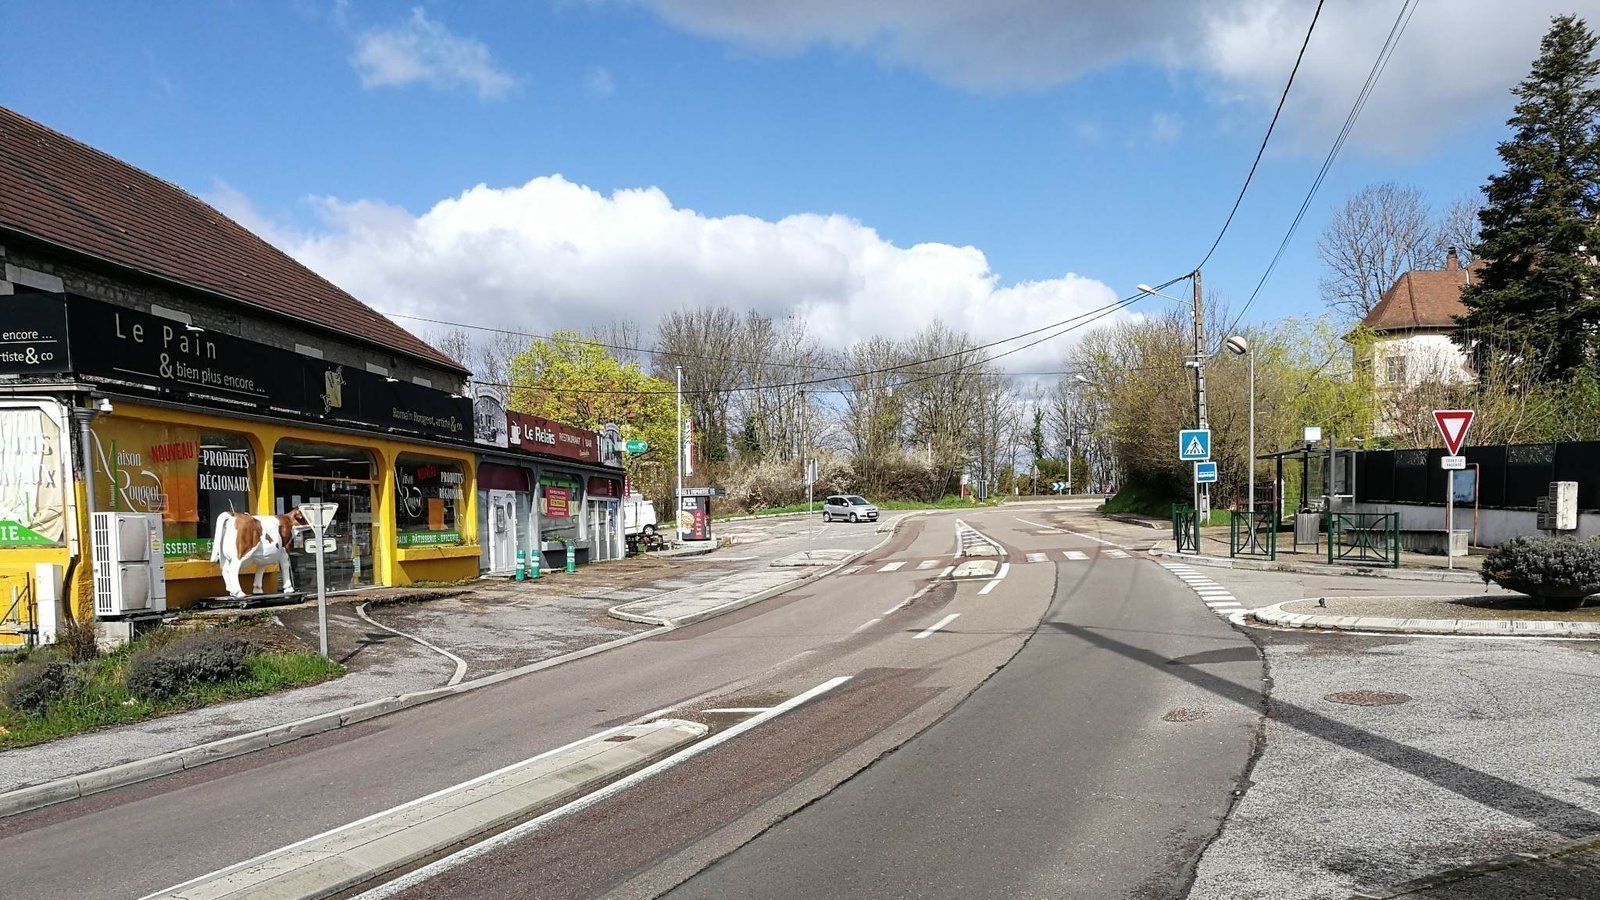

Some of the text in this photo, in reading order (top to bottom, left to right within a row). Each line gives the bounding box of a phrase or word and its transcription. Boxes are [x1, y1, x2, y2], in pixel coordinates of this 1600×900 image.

[2, 331, 39, 341] encore
[115, 313, 216, 359] Le Pain
[41, 352, 54, 361] co
[159, 352, 174, 379] &
[177, 361, 199, 380] bien
[202, 368, 222, 384] plus
[223, 374, 254, 391] encore
[524, 423, 534, 441] Le
[535, 426, 555, 445] Relais
[151, 441, 193, 464] NOUVEAU
[203, 449, 250, 469] PRODUITS
[200, 471, 251, 493] RÉGIONAUX
[163, 542, 197, 554] ISSERIE
